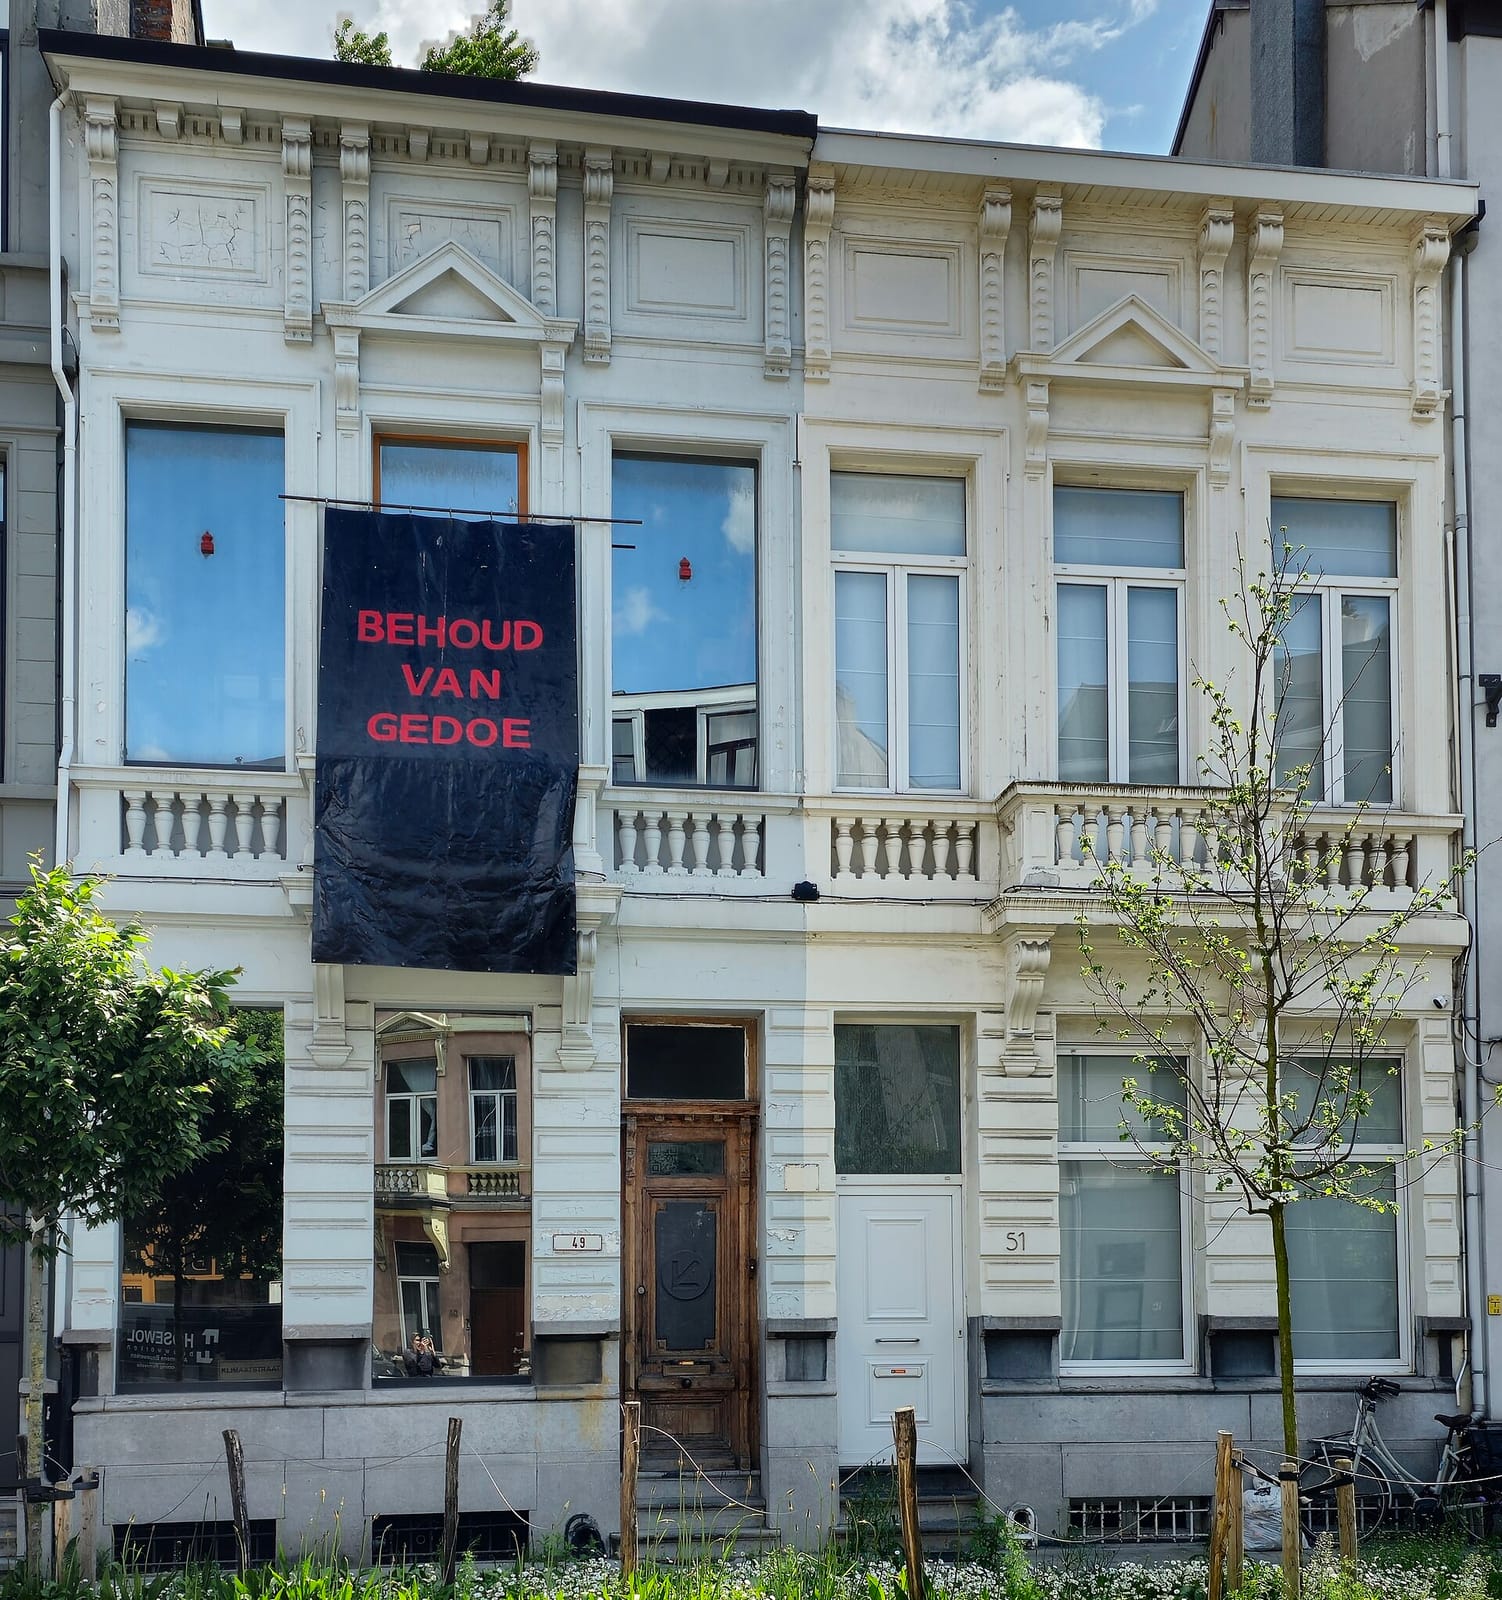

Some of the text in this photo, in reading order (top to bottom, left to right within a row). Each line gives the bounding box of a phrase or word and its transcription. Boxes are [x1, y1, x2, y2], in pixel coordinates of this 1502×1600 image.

[357, 609, 544, 652] BEHOUD
[401, 664, 501, 700] VAN
[366, 712, 532, 750] GEDOE
[572, 1236, 586, 1249] 49
[1006, 1231, 1025, 1251] 51
